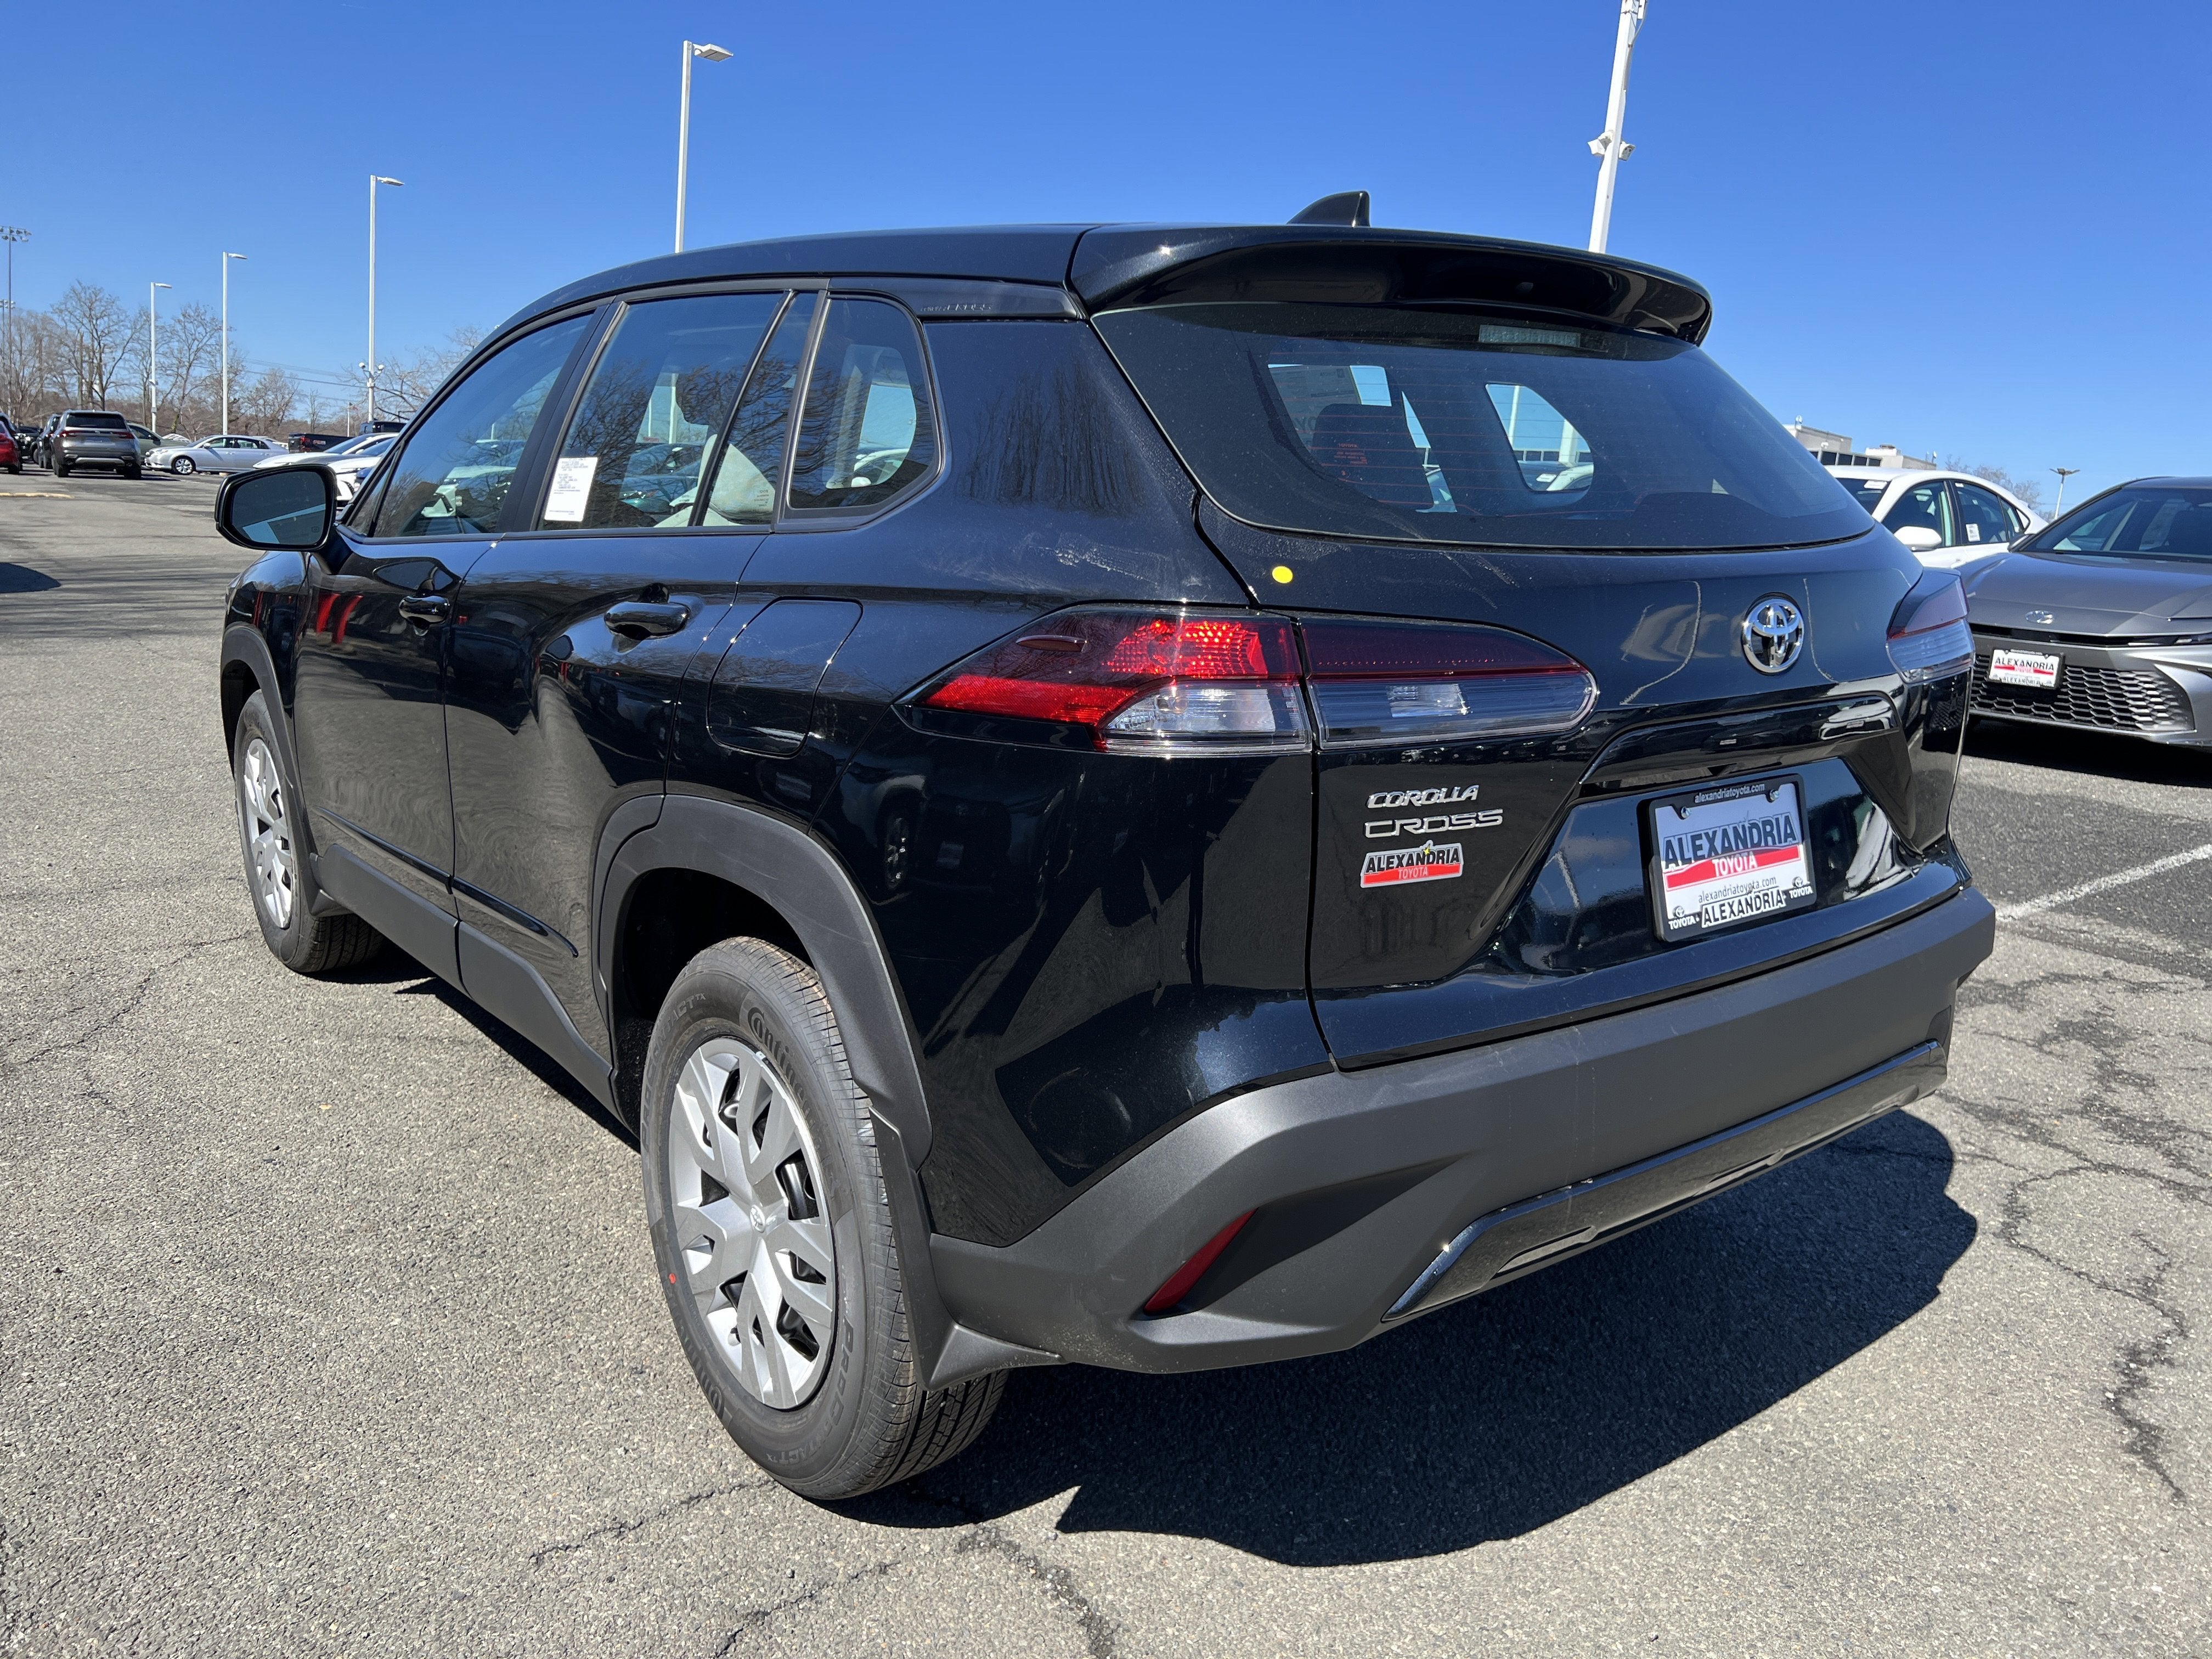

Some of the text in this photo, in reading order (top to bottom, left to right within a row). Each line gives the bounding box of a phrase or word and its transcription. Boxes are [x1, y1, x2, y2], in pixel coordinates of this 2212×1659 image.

[1995, 656, 2055, 671] ALEXANDRIA
[1367, 785, 1480, 809] COROLLA
[1695, 782, 1765, 803] alexandriatoyota.com
[1364, 808, 1503, 838] CROSS
[1663, 814, 1798, 871] ALEXANDRIA
[1365, 847, 1460, 873] ALEXANDRIA
[1398, 865, 1428, 879] TOYOTA
[1712, 851, 1758, 877] TOYOTA
[1699, 876, 1776, 903] alexandriatoyota.com
[1668, 886, 1813, 930] TOYOTA ALEXANDRIA TOYOTA
